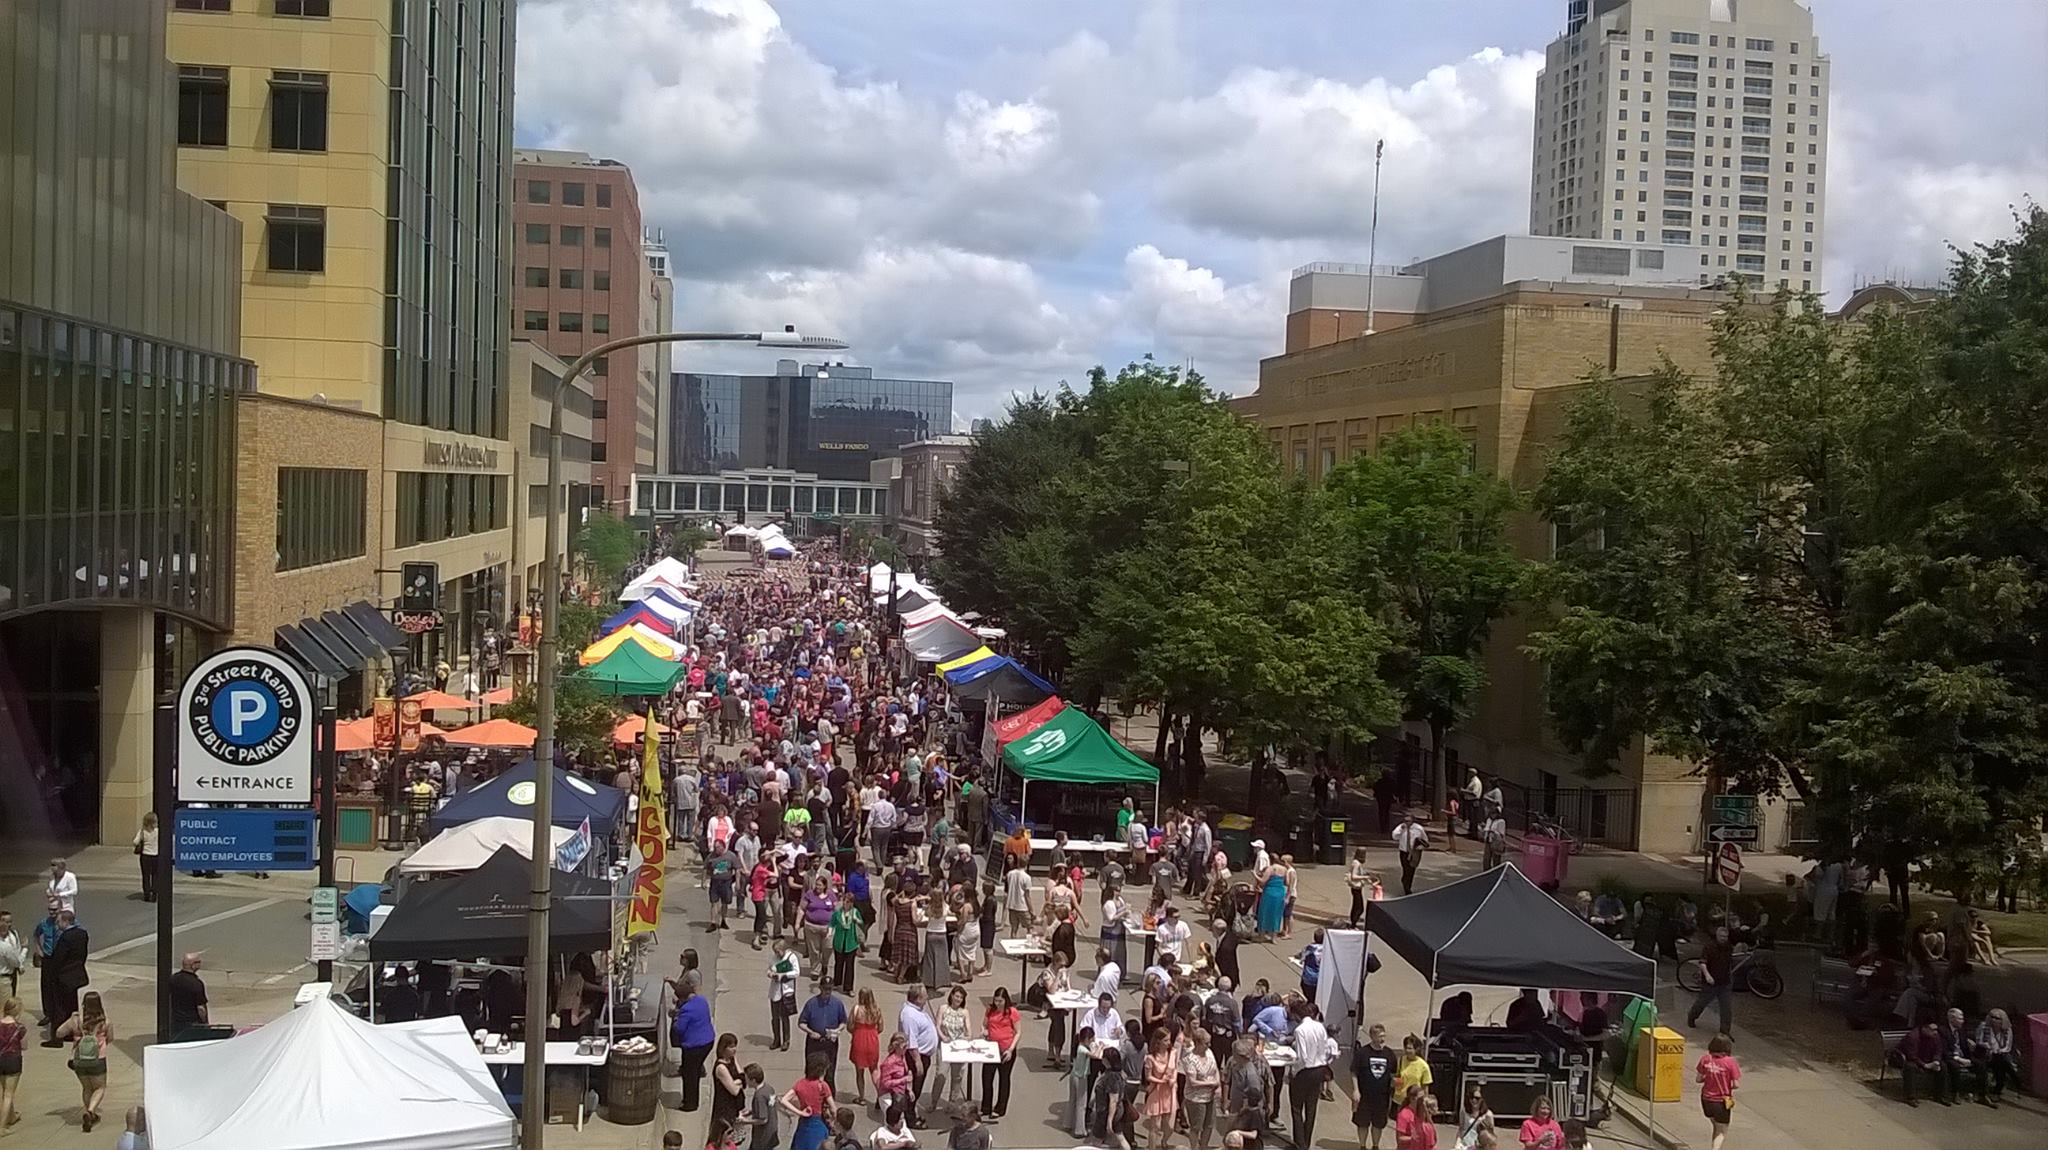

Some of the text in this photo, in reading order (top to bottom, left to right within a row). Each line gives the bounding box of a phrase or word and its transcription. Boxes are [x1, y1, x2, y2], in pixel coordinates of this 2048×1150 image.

[818, 442, 843, 450] WELLS
[194, 664, 294, 709] 3rd Street Ramp
[230, 690, 267, 737] P
[194, 715, 296, 762] PUBLIC PARKING
[211, 776, 294, 789] ENTRANCE
[180, 820, 218, 829] PUBLIC
[180, 836, 237, 845] CONTRACT
[180, 852, 273, 861] MAYO EMPLOYEES
[631, 806, 664, 925] CORN
